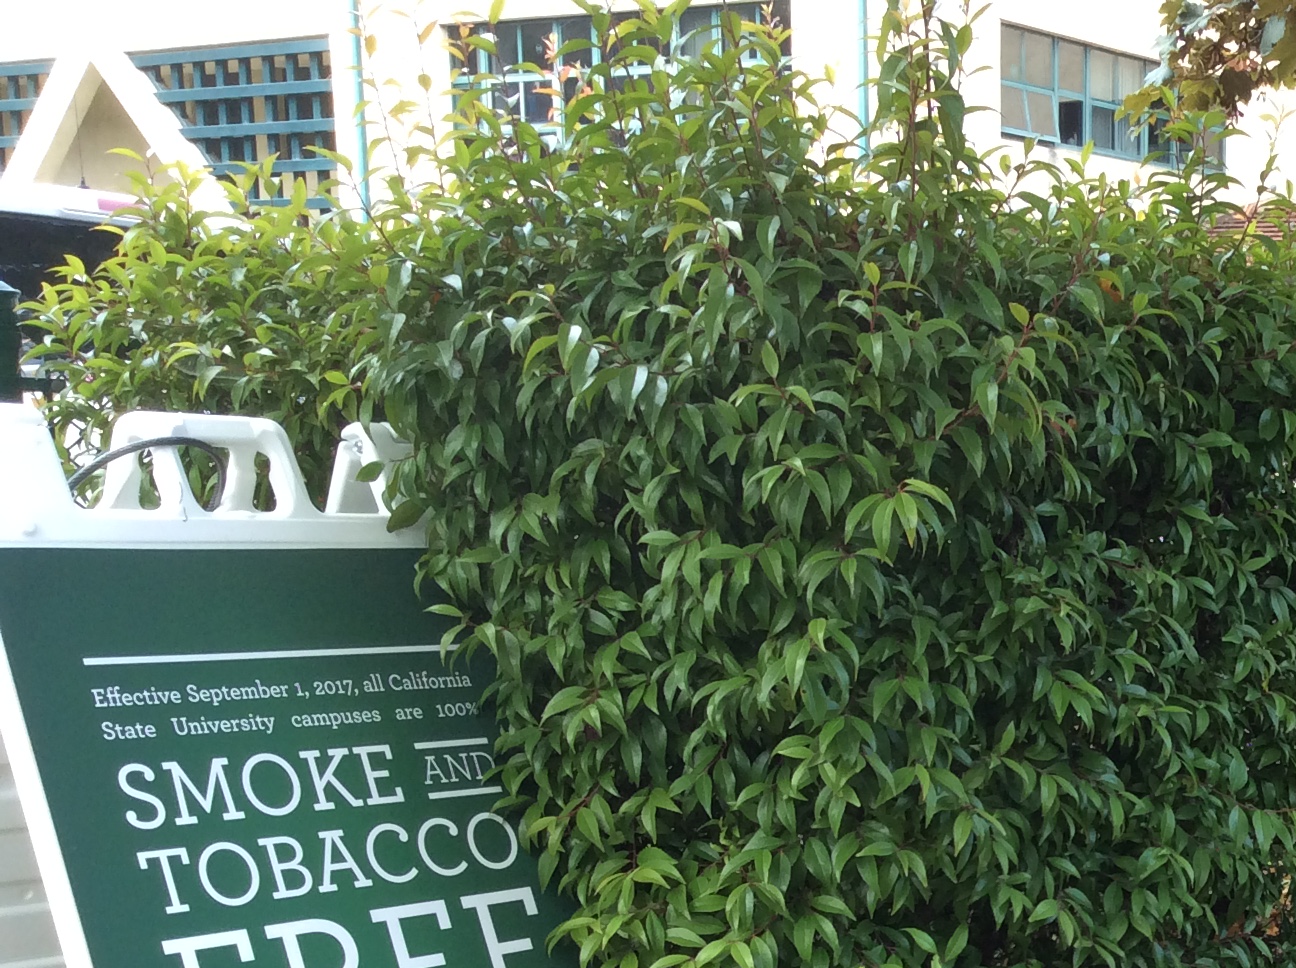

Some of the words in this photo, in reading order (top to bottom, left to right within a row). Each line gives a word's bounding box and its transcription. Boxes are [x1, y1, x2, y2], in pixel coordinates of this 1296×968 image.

[91, 686, 182, 708] Effective
[186, 679, 289, 706] September
[294, 681, 309, 699] 1,
[314, 678, 359, 697] 2017,
[363, 676, 386, 693] all
[388, 671, 473, 691] California
[101, 720, 157, 741] State
[171, 712, 276, 736] University
[291, 709, 382, 730] campuses
[396, 704, 424, 721] are
[117, 744, 405, 830] SMOKE
[424, 751, 496, 785] AND
[137, 811, 519, 915] TOBACCO
